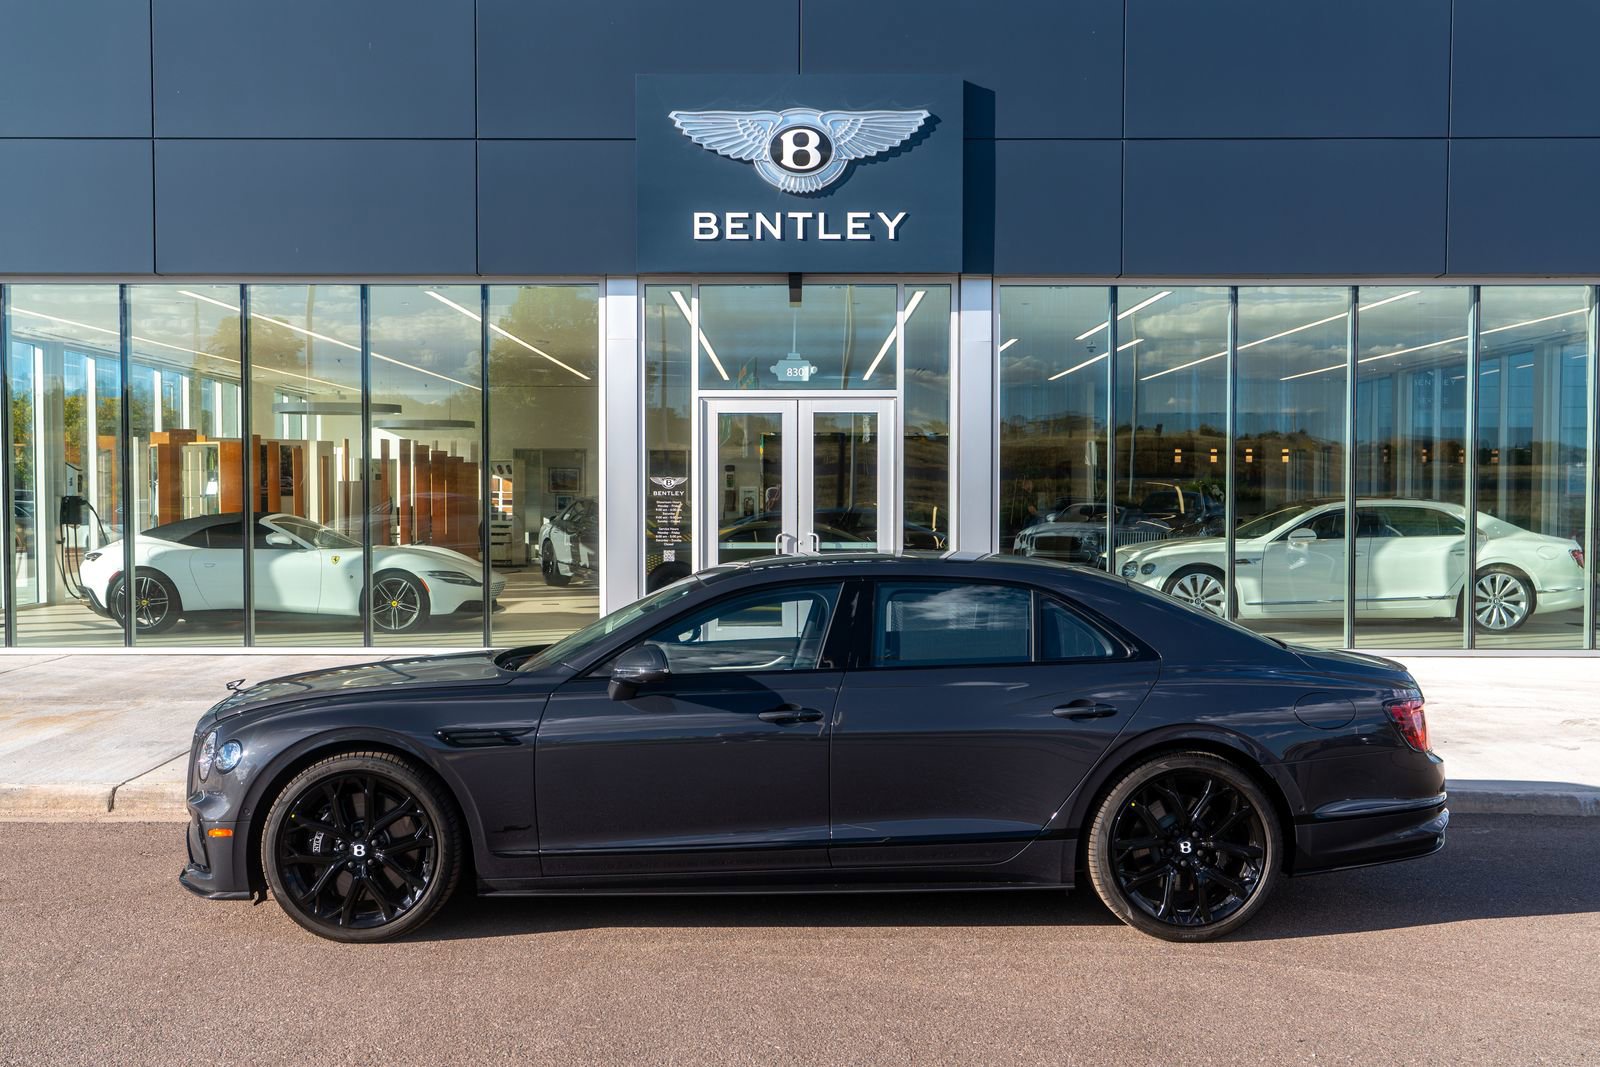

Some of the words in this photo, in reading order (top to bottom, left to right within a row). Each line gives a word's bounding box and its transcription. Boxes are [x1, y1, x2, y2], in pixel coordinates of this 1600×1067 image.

[780, 128, 821, 170] B
[693, 212, 906, 240] BENTLEY
[353, 844, 365, 857] B
[1180, 841, 1192, 854] B
